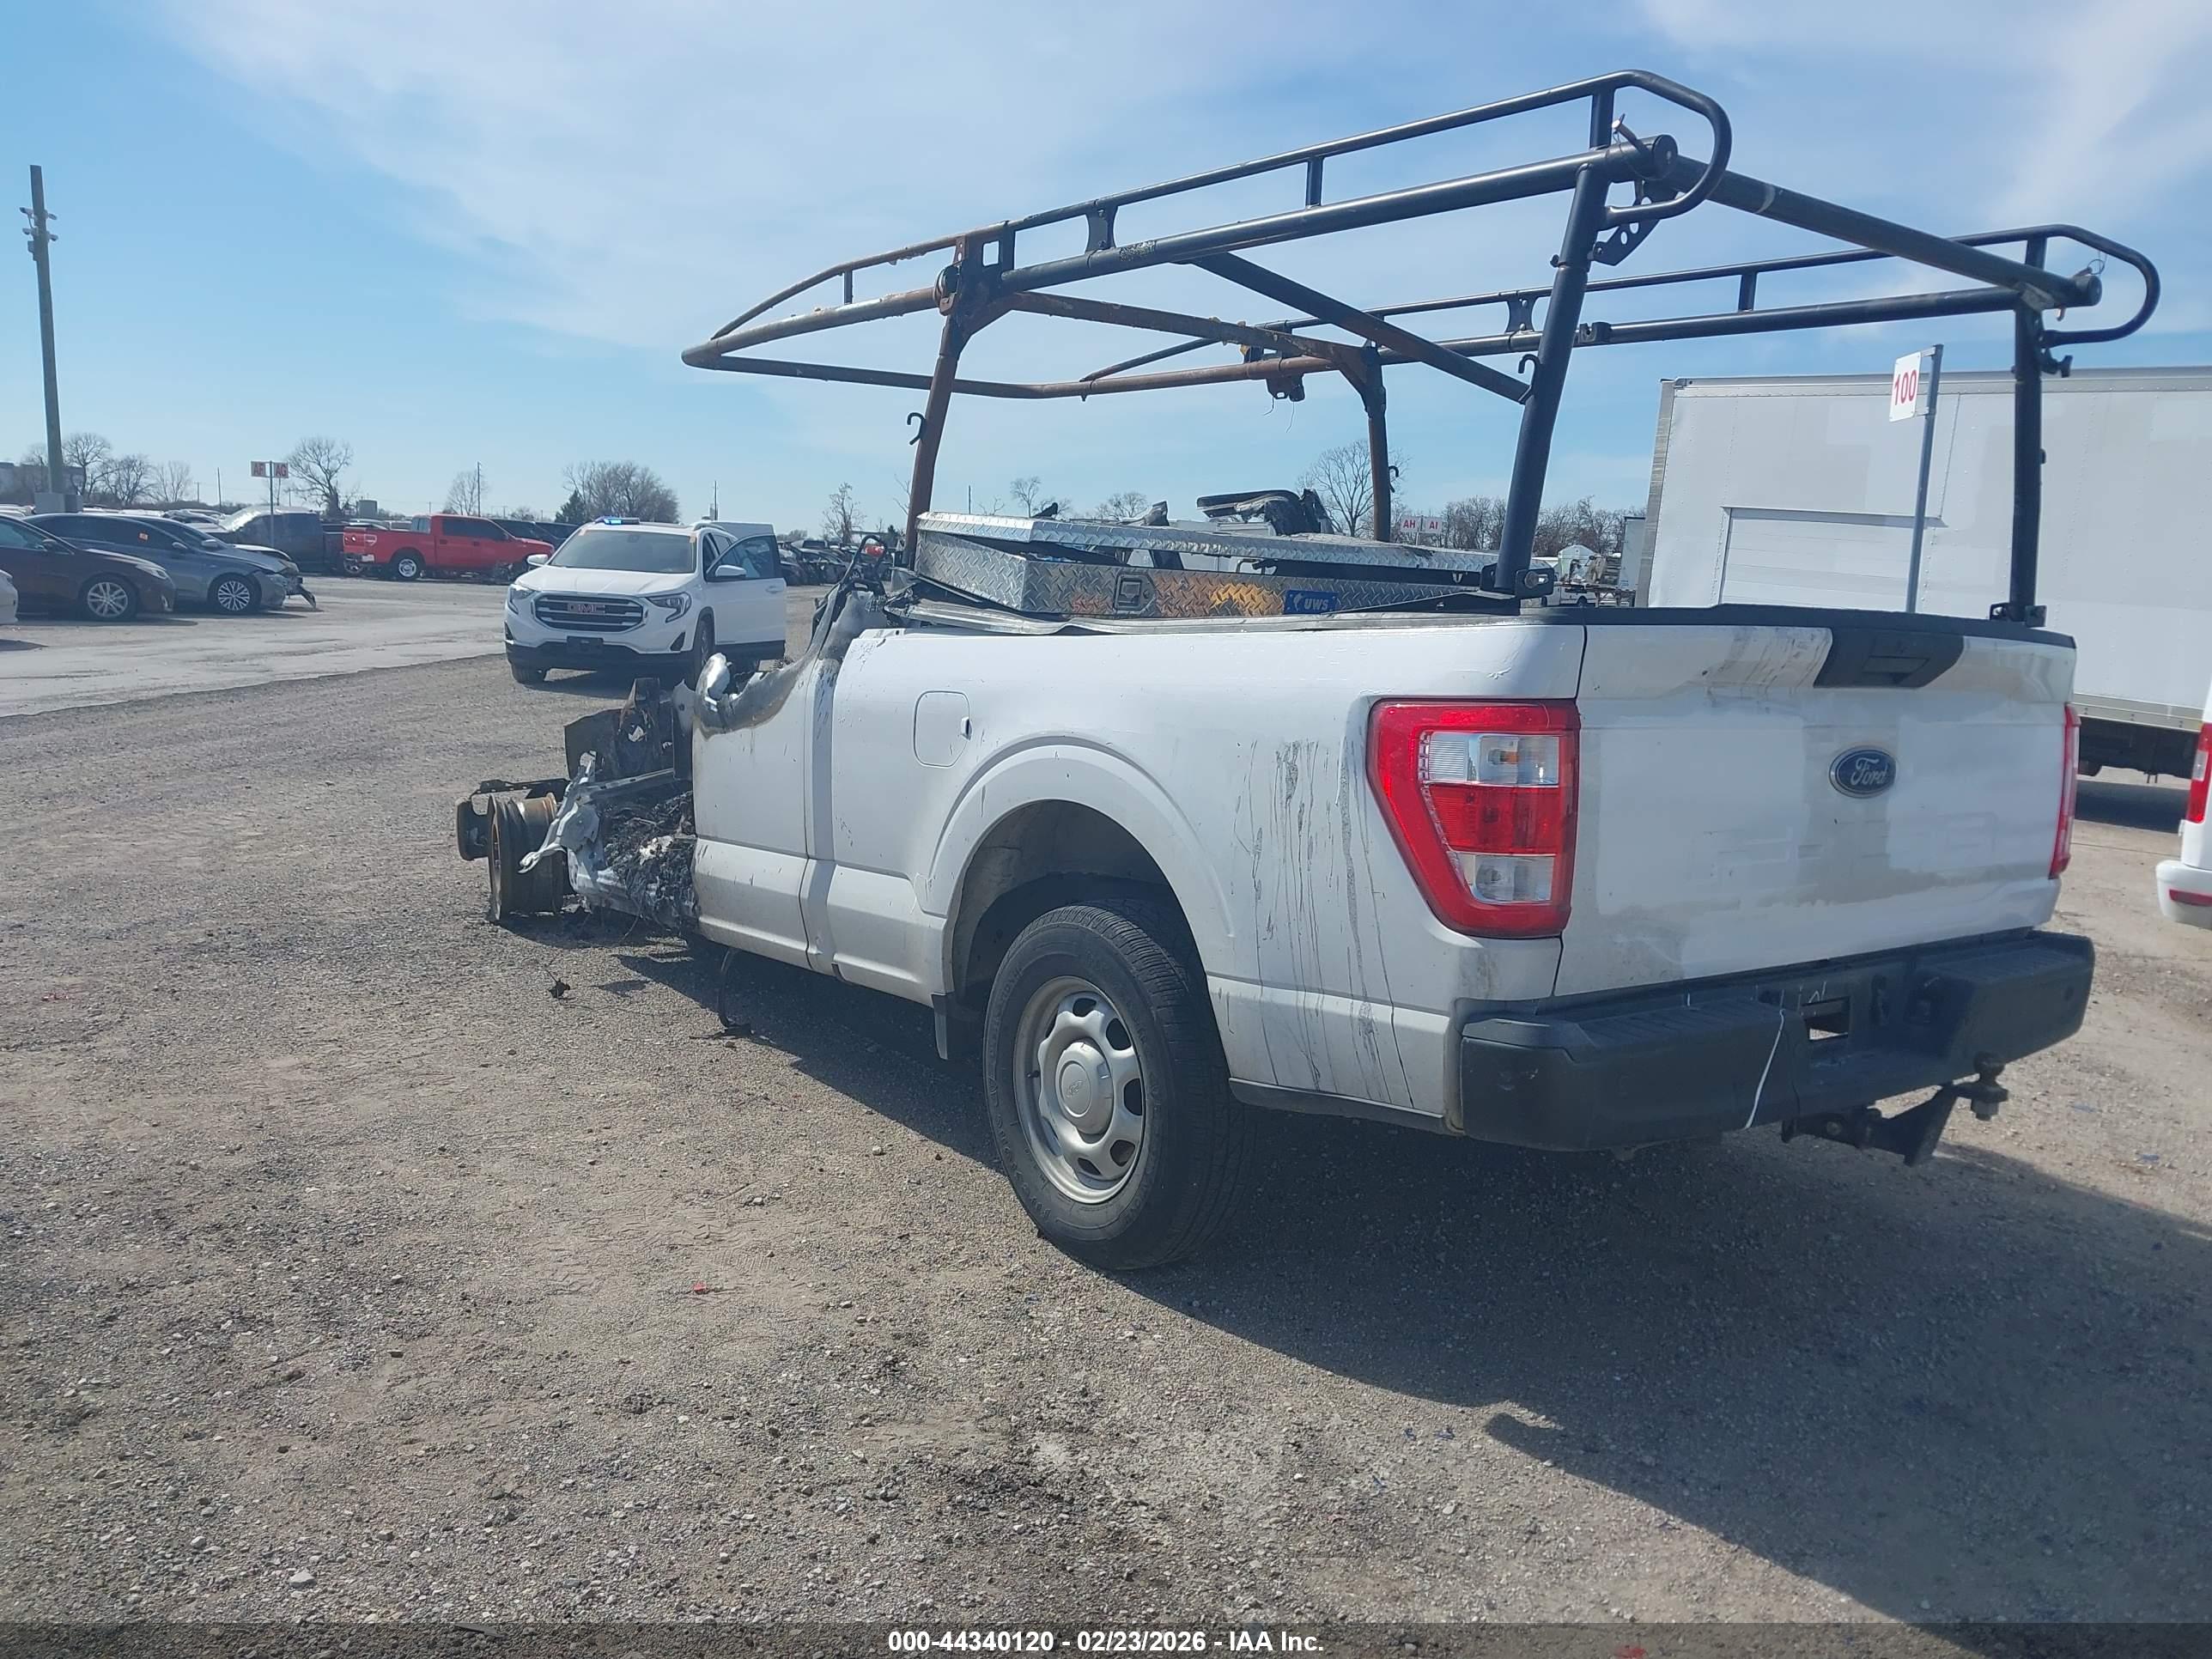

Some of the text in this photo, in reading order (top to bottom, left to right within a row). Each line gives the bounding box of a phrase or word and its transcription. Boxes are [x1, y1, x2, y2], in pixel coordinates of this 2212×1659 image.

[1894, 369, 1917, 406] 100
[275, 464, 288, 477] AG
[1402, 519, 1416, 529] AH
[1429, 521, 1439, 530] AI
[567, 603, 605, 614] GMC
[1304, 598, 1329, 611] UWS
[1850, 757, 1888, 786] Ford
